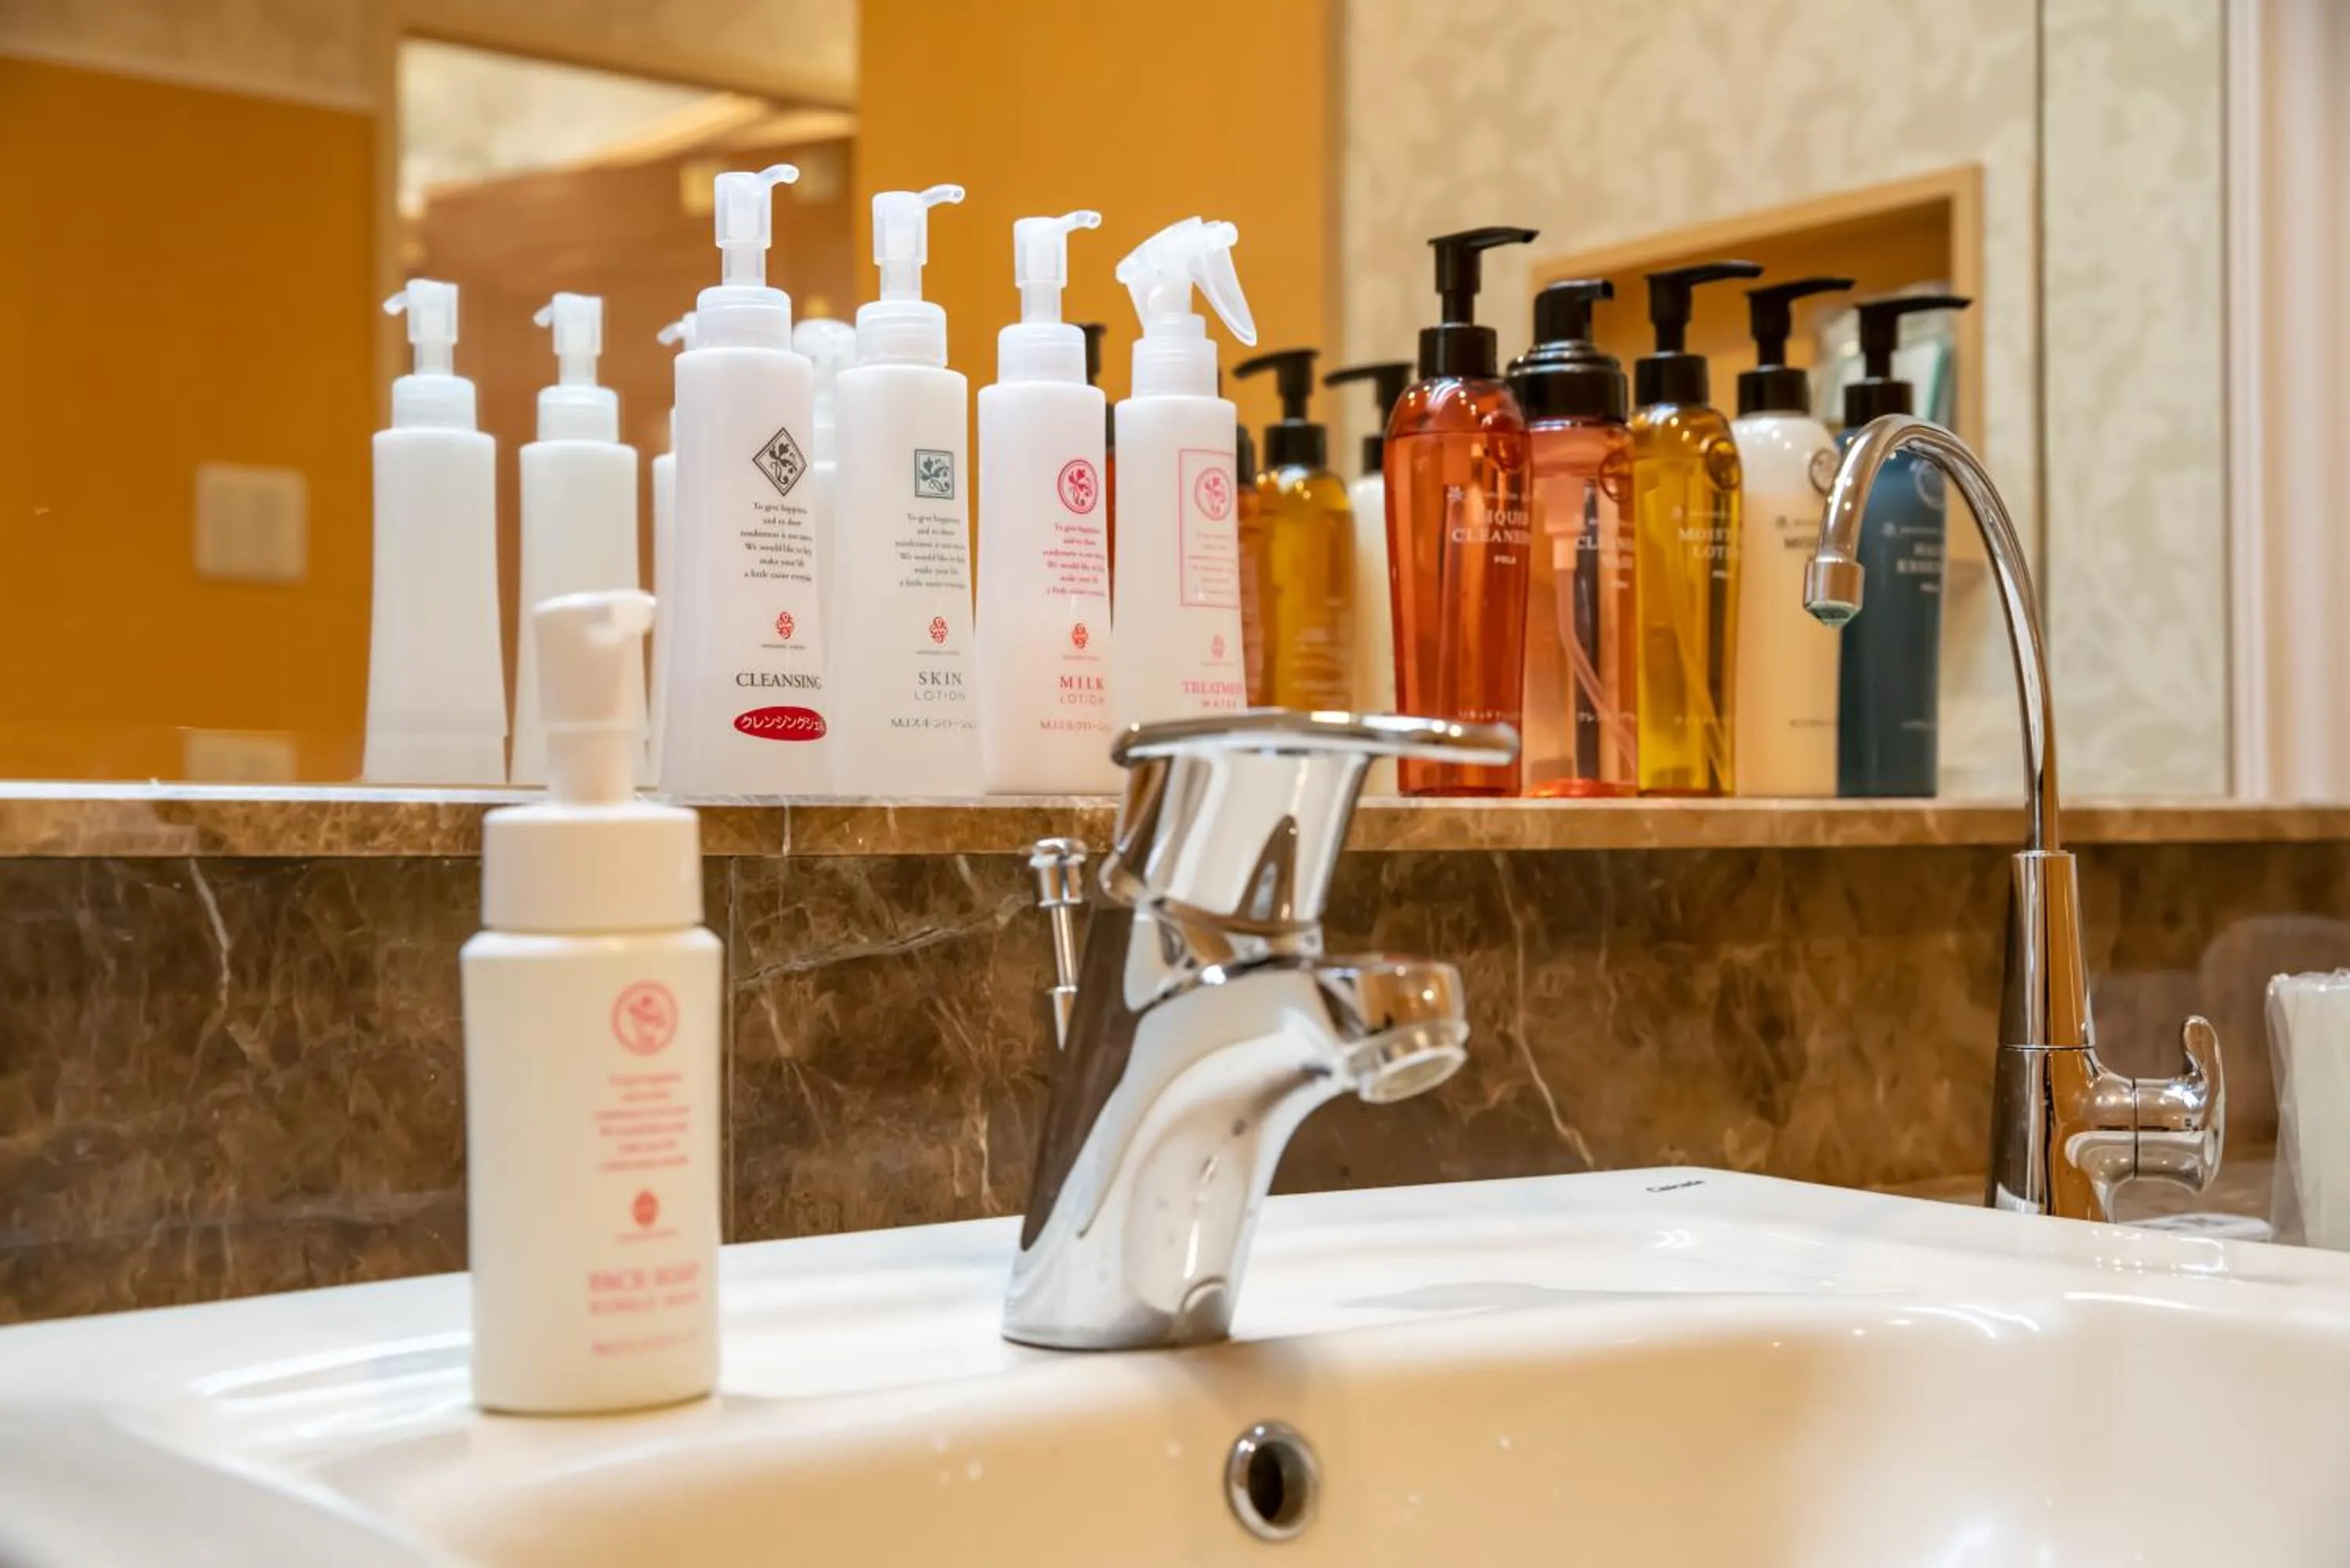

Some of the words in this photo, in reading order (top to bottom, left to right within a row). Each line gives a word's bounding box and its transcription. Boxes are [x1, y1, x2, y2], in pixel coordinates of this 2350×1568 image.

[736, 672, 822, 690] CLEANSING
[918, 671, 963, 687] SKIN
[1060, 676, 1104, 691] MILK
[913, 690, 967, 702] LOTION
